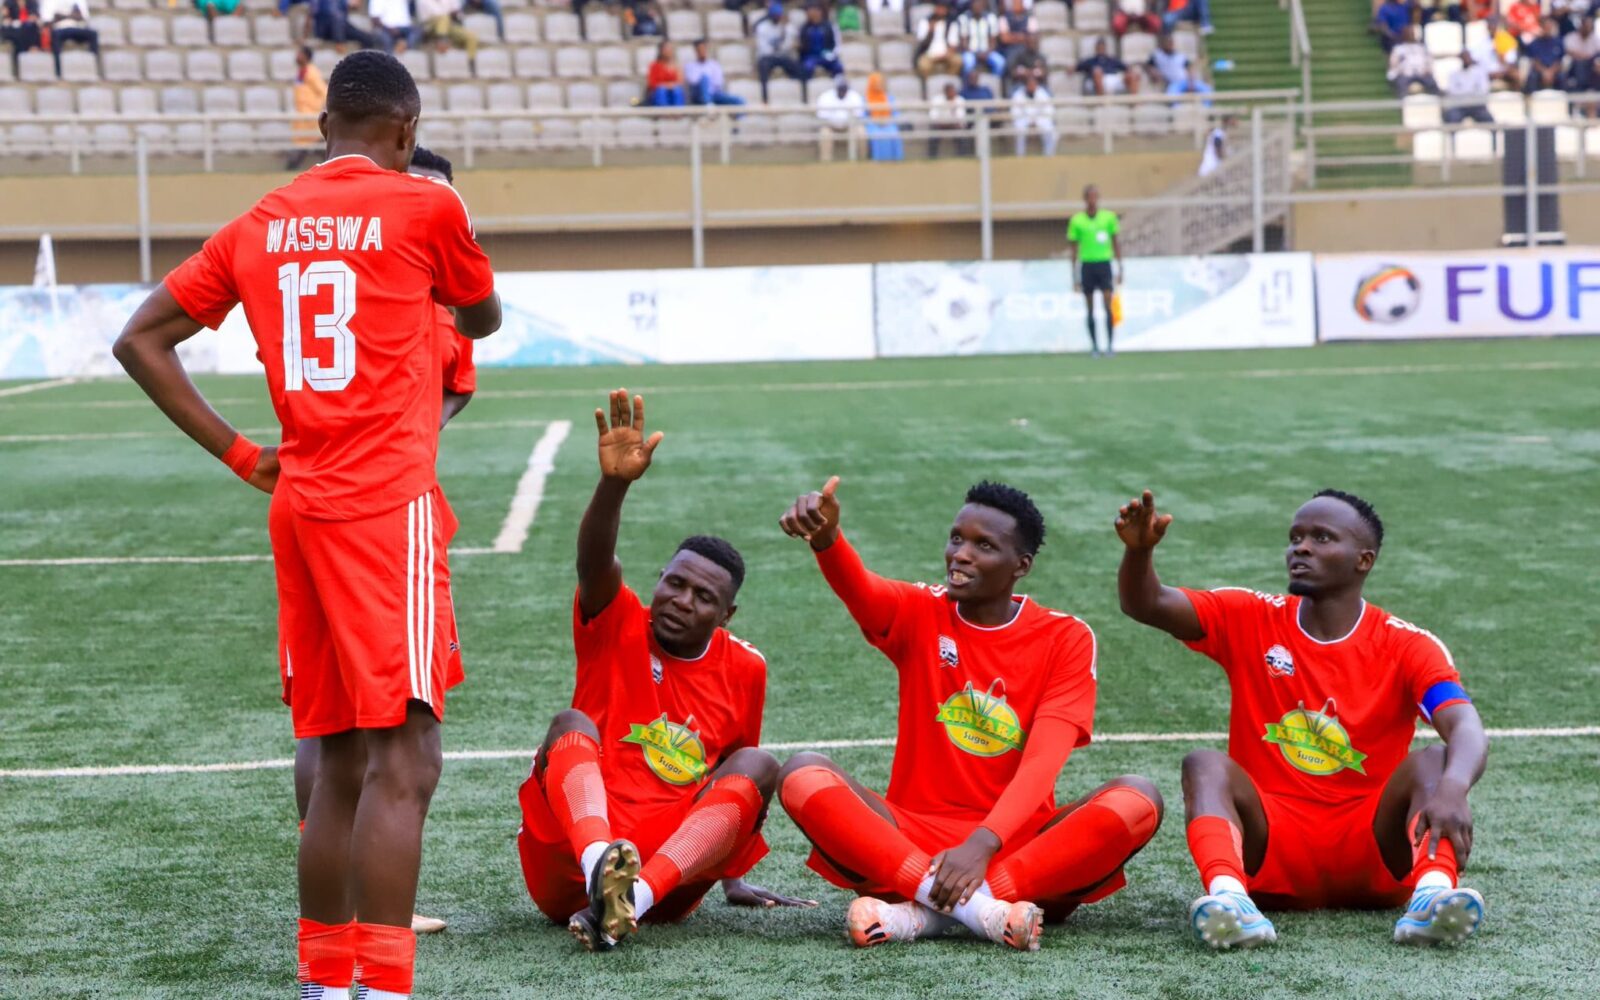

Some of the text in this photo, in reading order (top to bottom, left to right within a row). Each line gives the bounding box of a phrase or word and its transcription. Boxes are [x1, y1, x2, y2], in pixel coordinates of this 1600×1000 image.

[266, 216, 382, 252] WASSWA
[1006, 289, 1173, 320] SOCER
[1446, 262, 1600, 322] FUF
[278, 260, 357, 391] 13
[942, 707, 1021, 745] KINYARA
[963, 731, 989, 746] Sugar
[639, 726, 706, 774] KINARA
[1277, 726, 1353, 763] KINYARA
[1297, 750, 1325, 765] Sugar
[659, 756, 682, 775] Sugar
